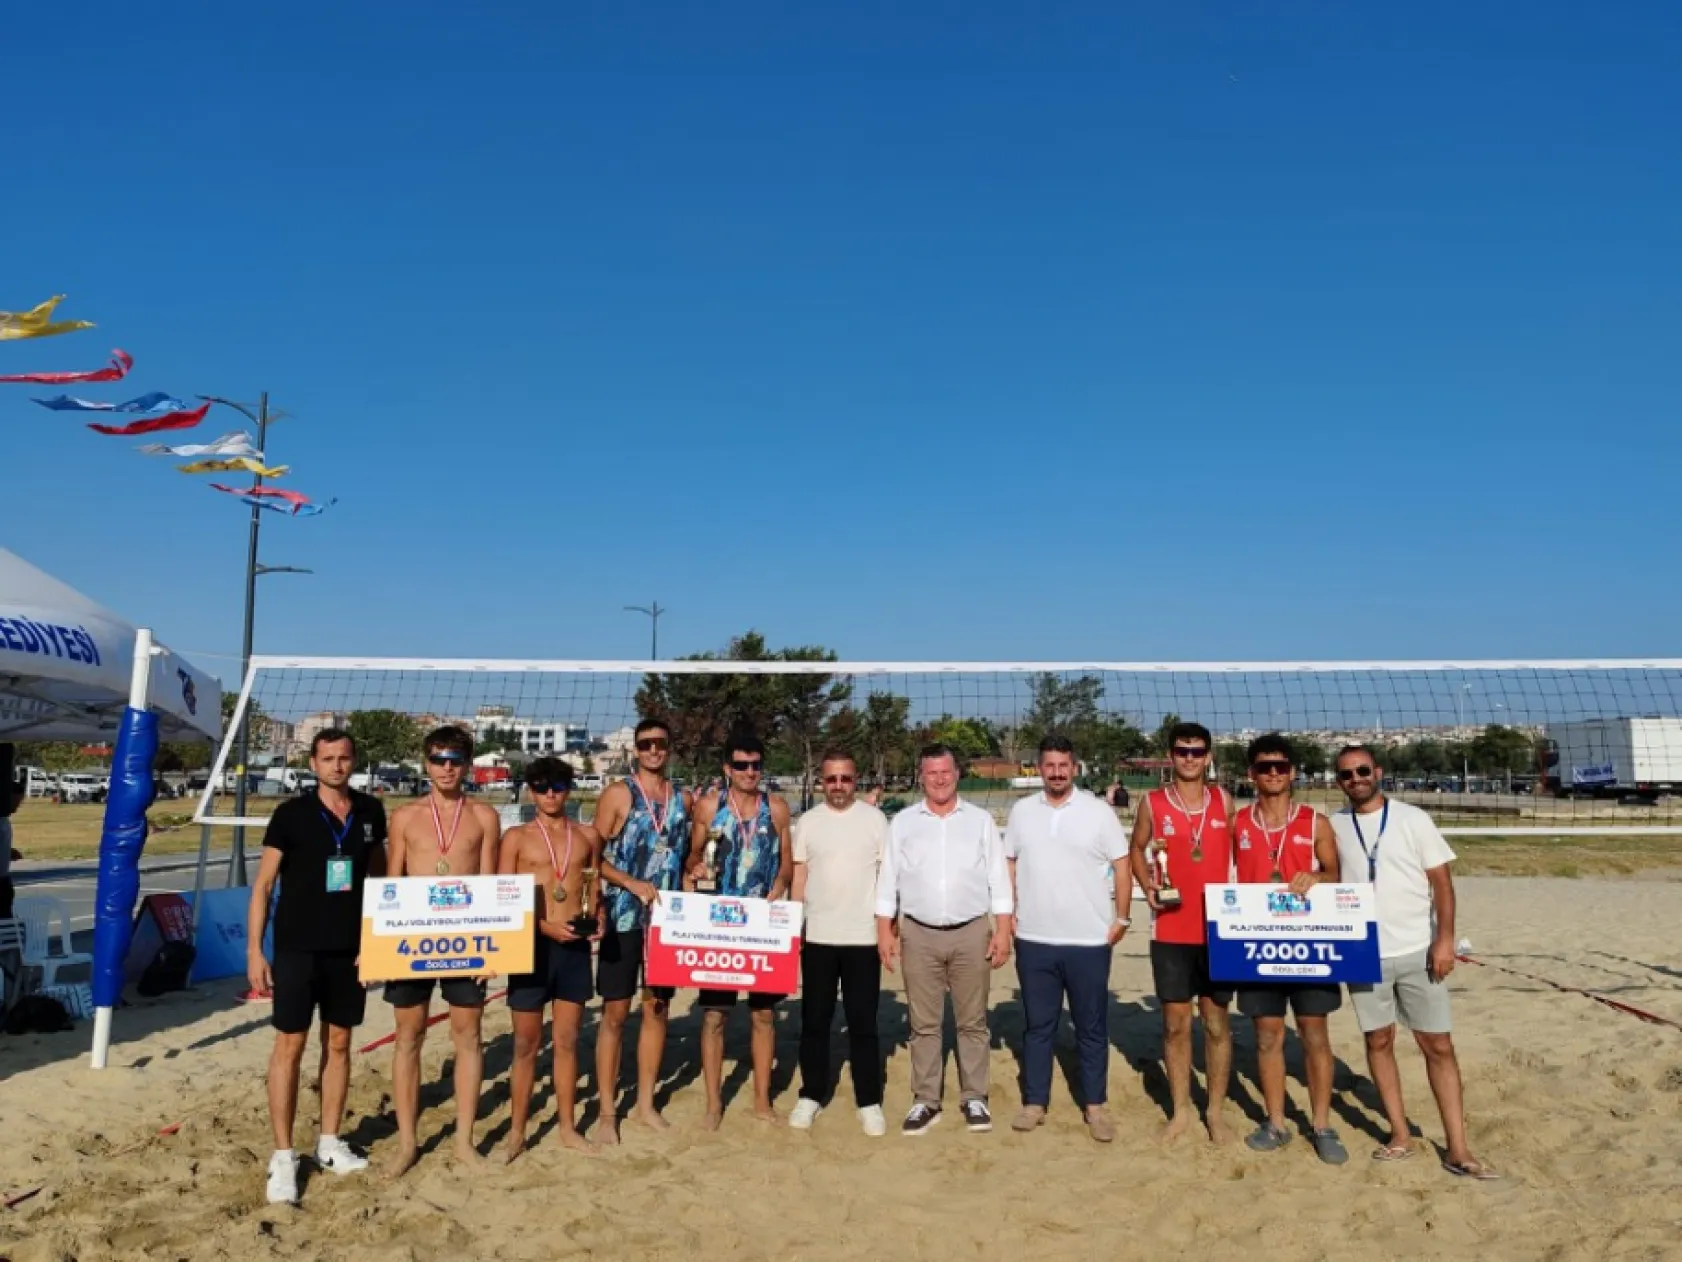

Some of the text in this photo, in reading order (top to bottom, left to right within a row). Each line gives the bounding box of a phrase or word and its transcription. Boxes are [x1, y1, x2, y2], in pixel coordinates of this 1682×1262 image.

[0, 614, 101, 666] EDİYESİ
[385, 915, 512, 927] PLAJ VOLEYBOLU TURNUVASI
[1229, 924, 1354, 932] PLAJ VOLEYBOLU TURNUVASI
[396, 935, 500, 956] 4.000 TL
[671, 930, 781, 945] PLAJ VOLEYBOLU TURNUVASI
[674, 949, 774, 972] 10.000 TL
[1243, 942, 1343, 961] 7.000 TL
